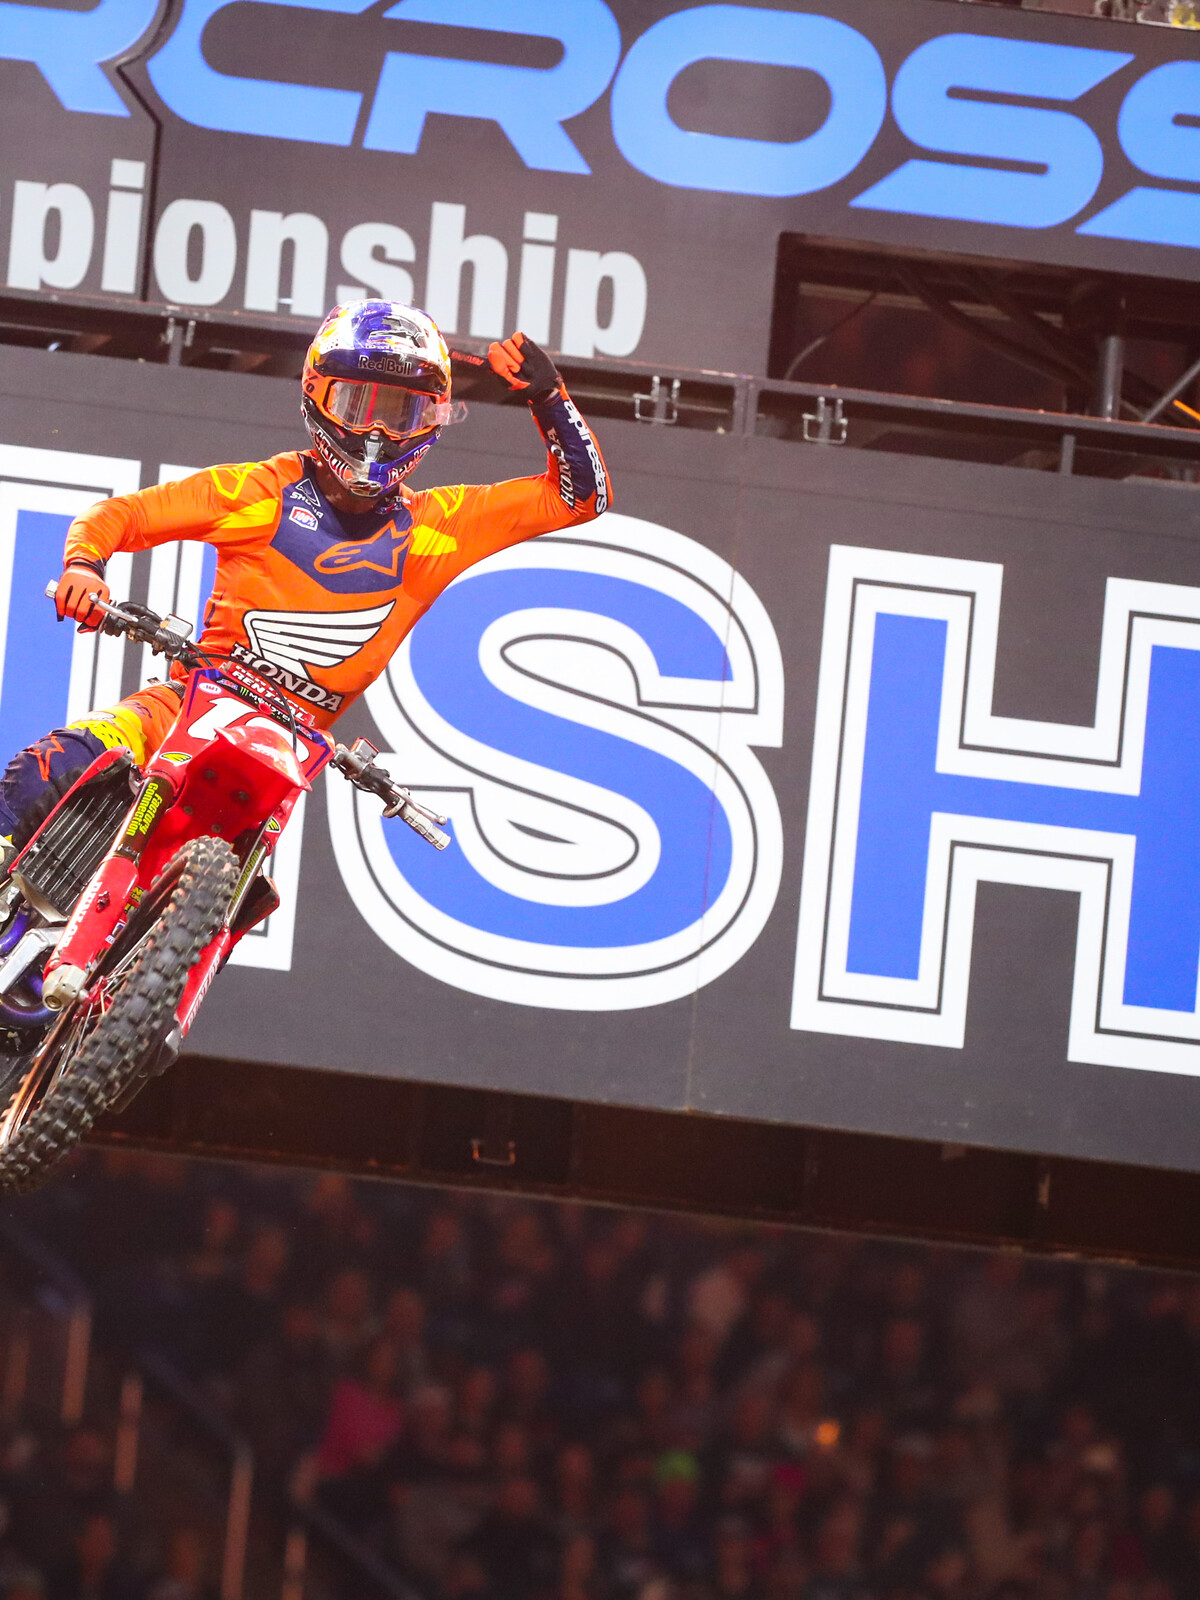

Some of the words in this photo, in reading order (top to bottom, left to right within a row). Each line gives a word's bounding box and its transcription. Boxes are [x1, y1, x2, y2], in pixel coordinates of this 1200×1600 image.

[359, 355, 386, 371] Red
[386, 358, 413, 376] Bull
[563, 400, 607, 515] alpinestars
[293, 509, 316, 528] 100%
[231, 643, 344, 712] HONDA
